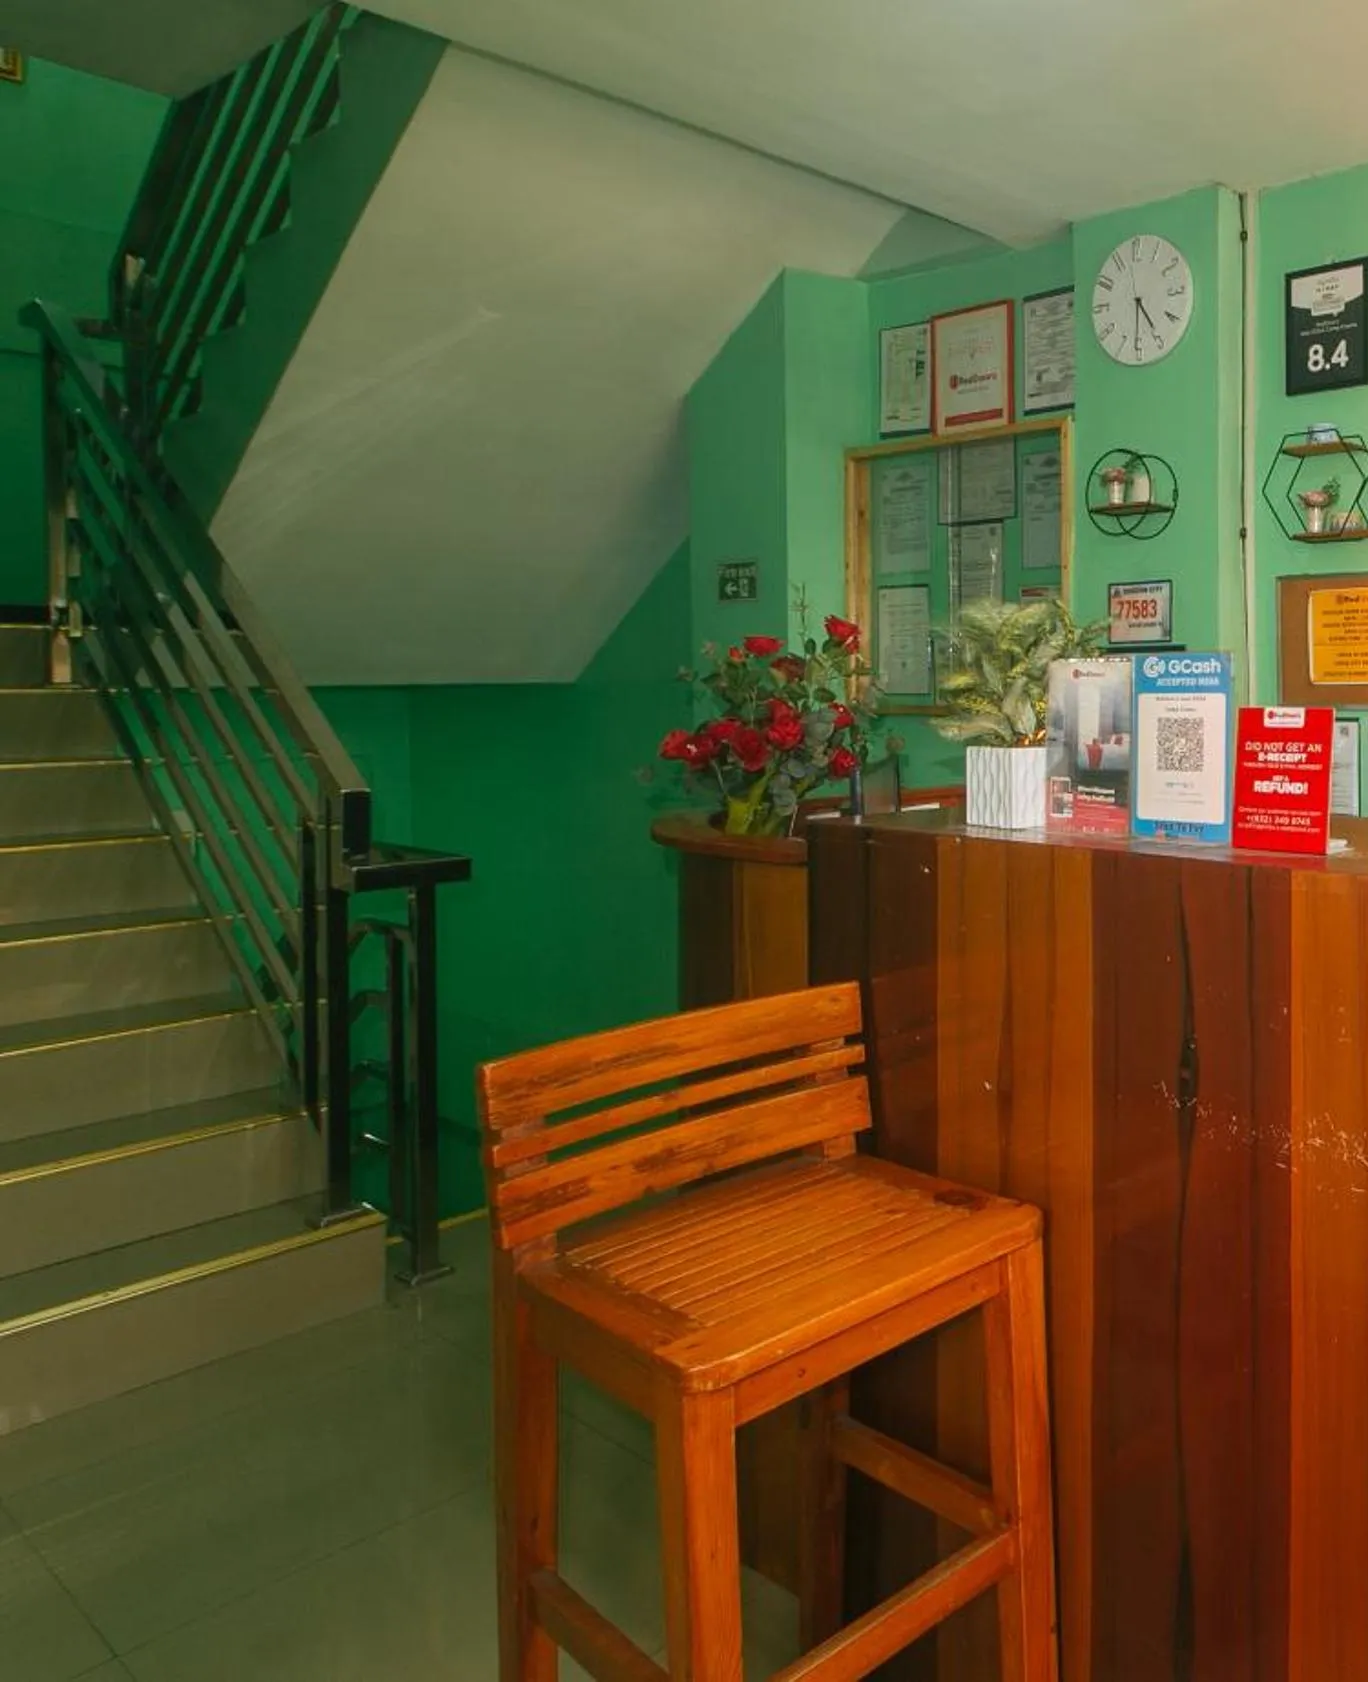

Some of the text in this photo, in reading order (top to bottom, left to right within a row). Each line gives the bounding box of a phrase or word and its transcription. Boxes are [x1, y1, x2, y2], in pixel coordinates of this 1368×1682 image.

[1307, 339, 1349, 373] 8.4
[1116, 599, 1157, 619] 77583
[1168, 657, 1222, 674] GCash
[1263, 741, 1285, 753] NOT
[1286, 742, 1305, 753] GET
[1307, 743, 1323, 753] AN
[1253, 780, 1309, 795] REFUND!
